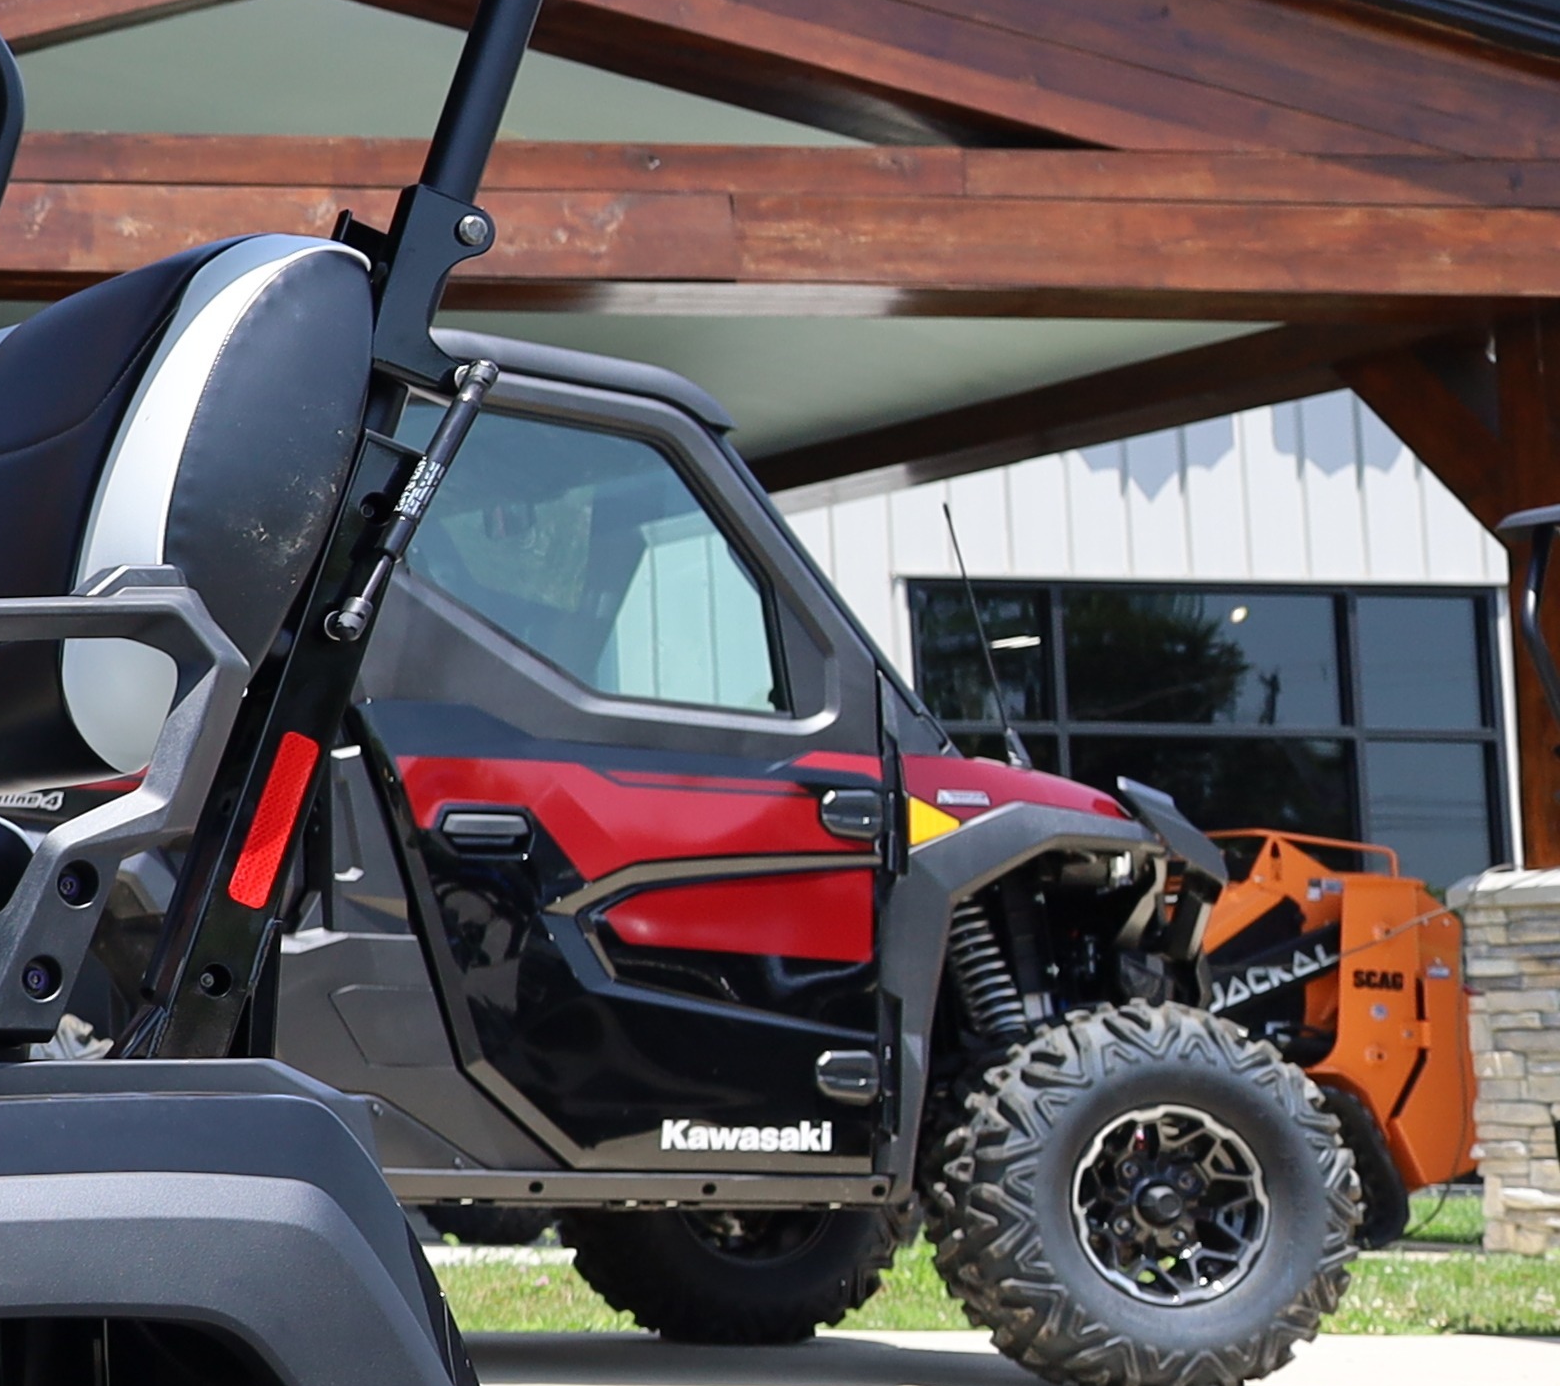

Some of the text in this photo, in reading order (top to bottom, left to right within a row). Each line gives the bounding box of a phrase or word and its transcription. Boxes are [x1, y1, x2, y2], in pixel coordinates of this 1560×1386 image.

[1209, 943, 1340, 1013] JACKAL
[1353, 969, 1404, 991] SCAG
[661, 1119, 833, 1152] Kawasaki
